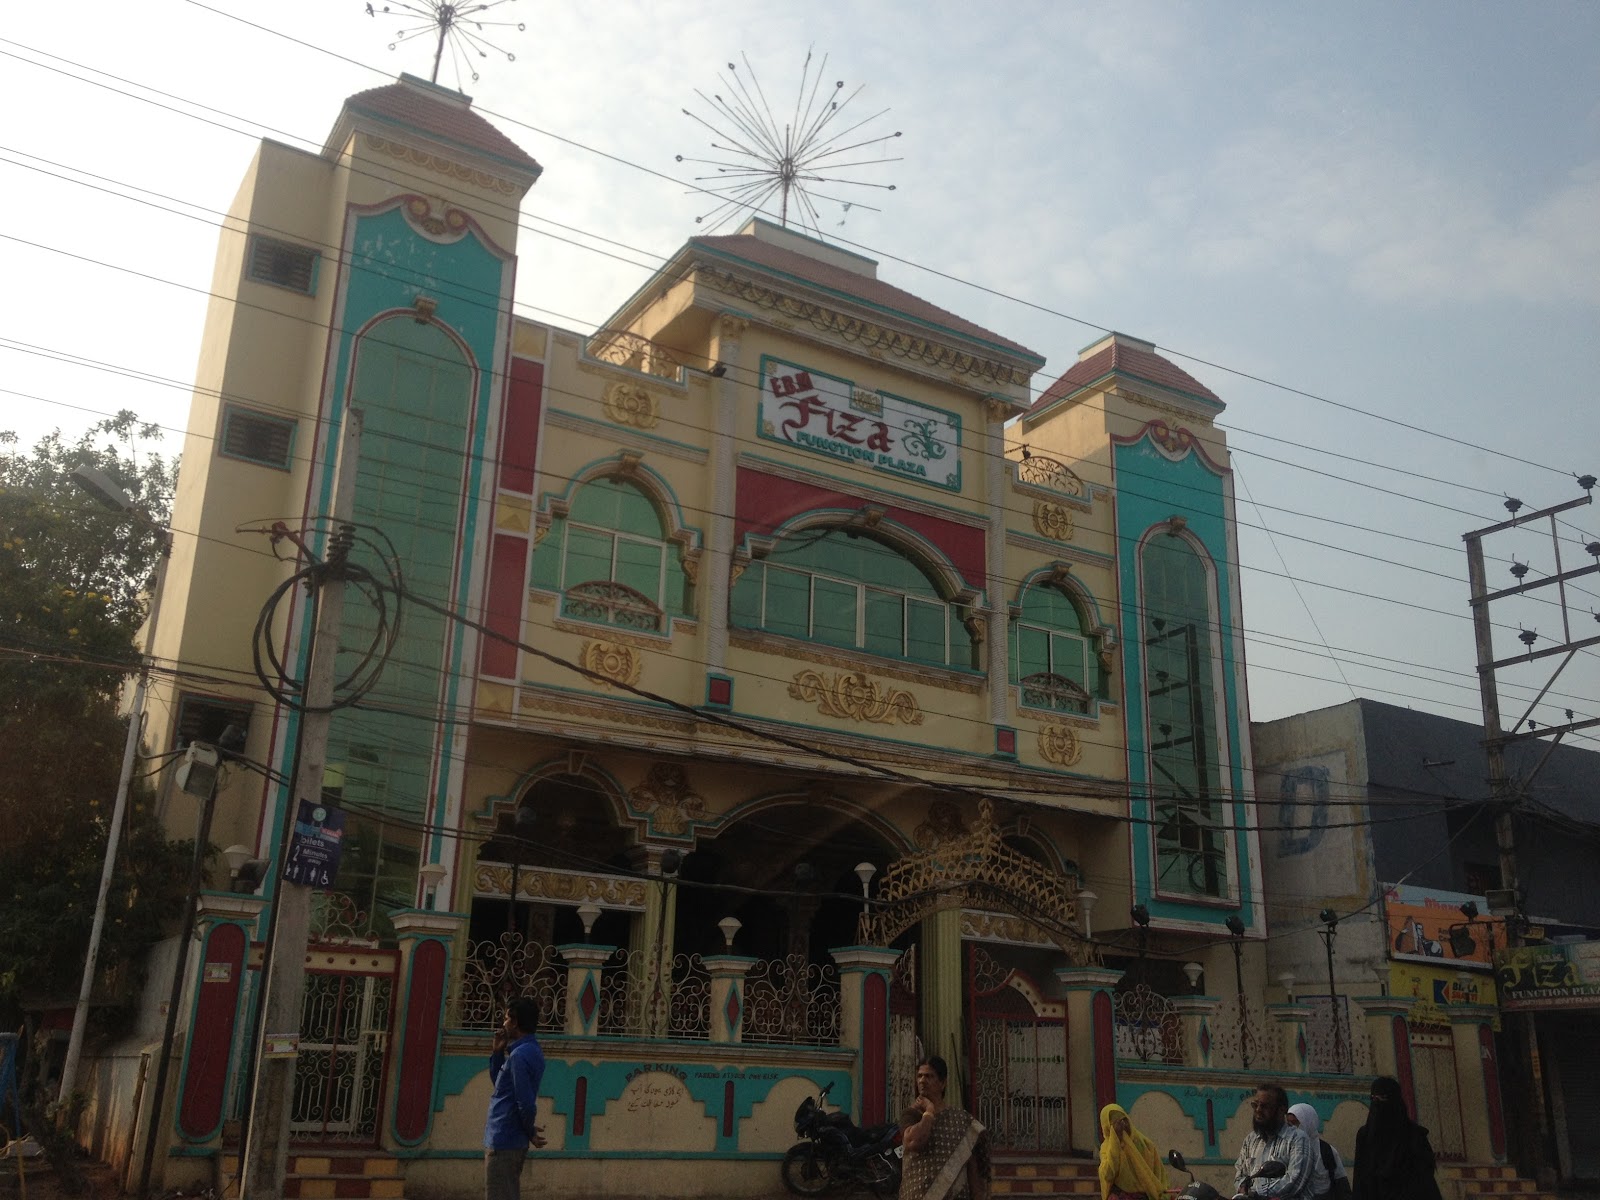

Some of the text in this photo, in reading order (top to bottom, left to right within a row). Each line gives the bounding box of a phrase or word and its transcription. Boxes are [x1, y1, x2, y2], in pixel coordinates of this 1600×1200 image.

[796, 431, 926, 477] FUNCTION PLAZA
[303, 848, 328, 859] Minutes
[1452, 982, 1478, 993] BILA
[1512, 987, 1569, 1000] FUNCTION
[625, 1063, 688, 1083] PARKING
